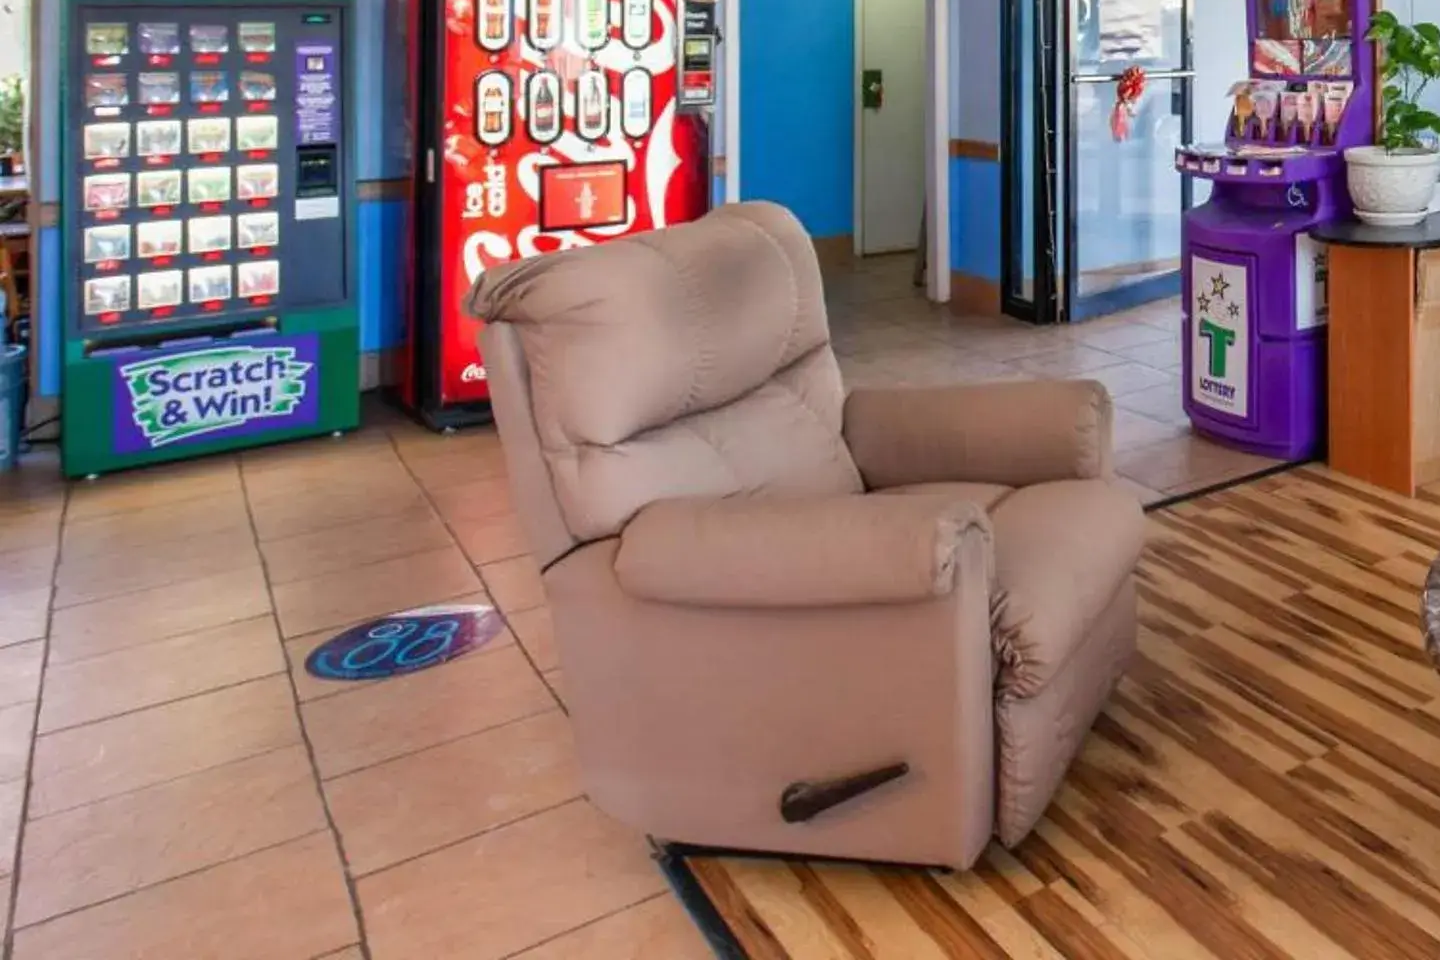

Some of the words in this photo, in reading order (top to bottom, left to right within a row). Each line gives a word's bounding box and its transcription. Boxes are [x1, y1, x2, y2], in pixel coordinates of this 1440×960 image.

[1199, 317, 1236, 378] T
[150, 355, 285, 396] Scratch
[160, 399, 188, 427] &
[193, 386, 272, 419] Win!
